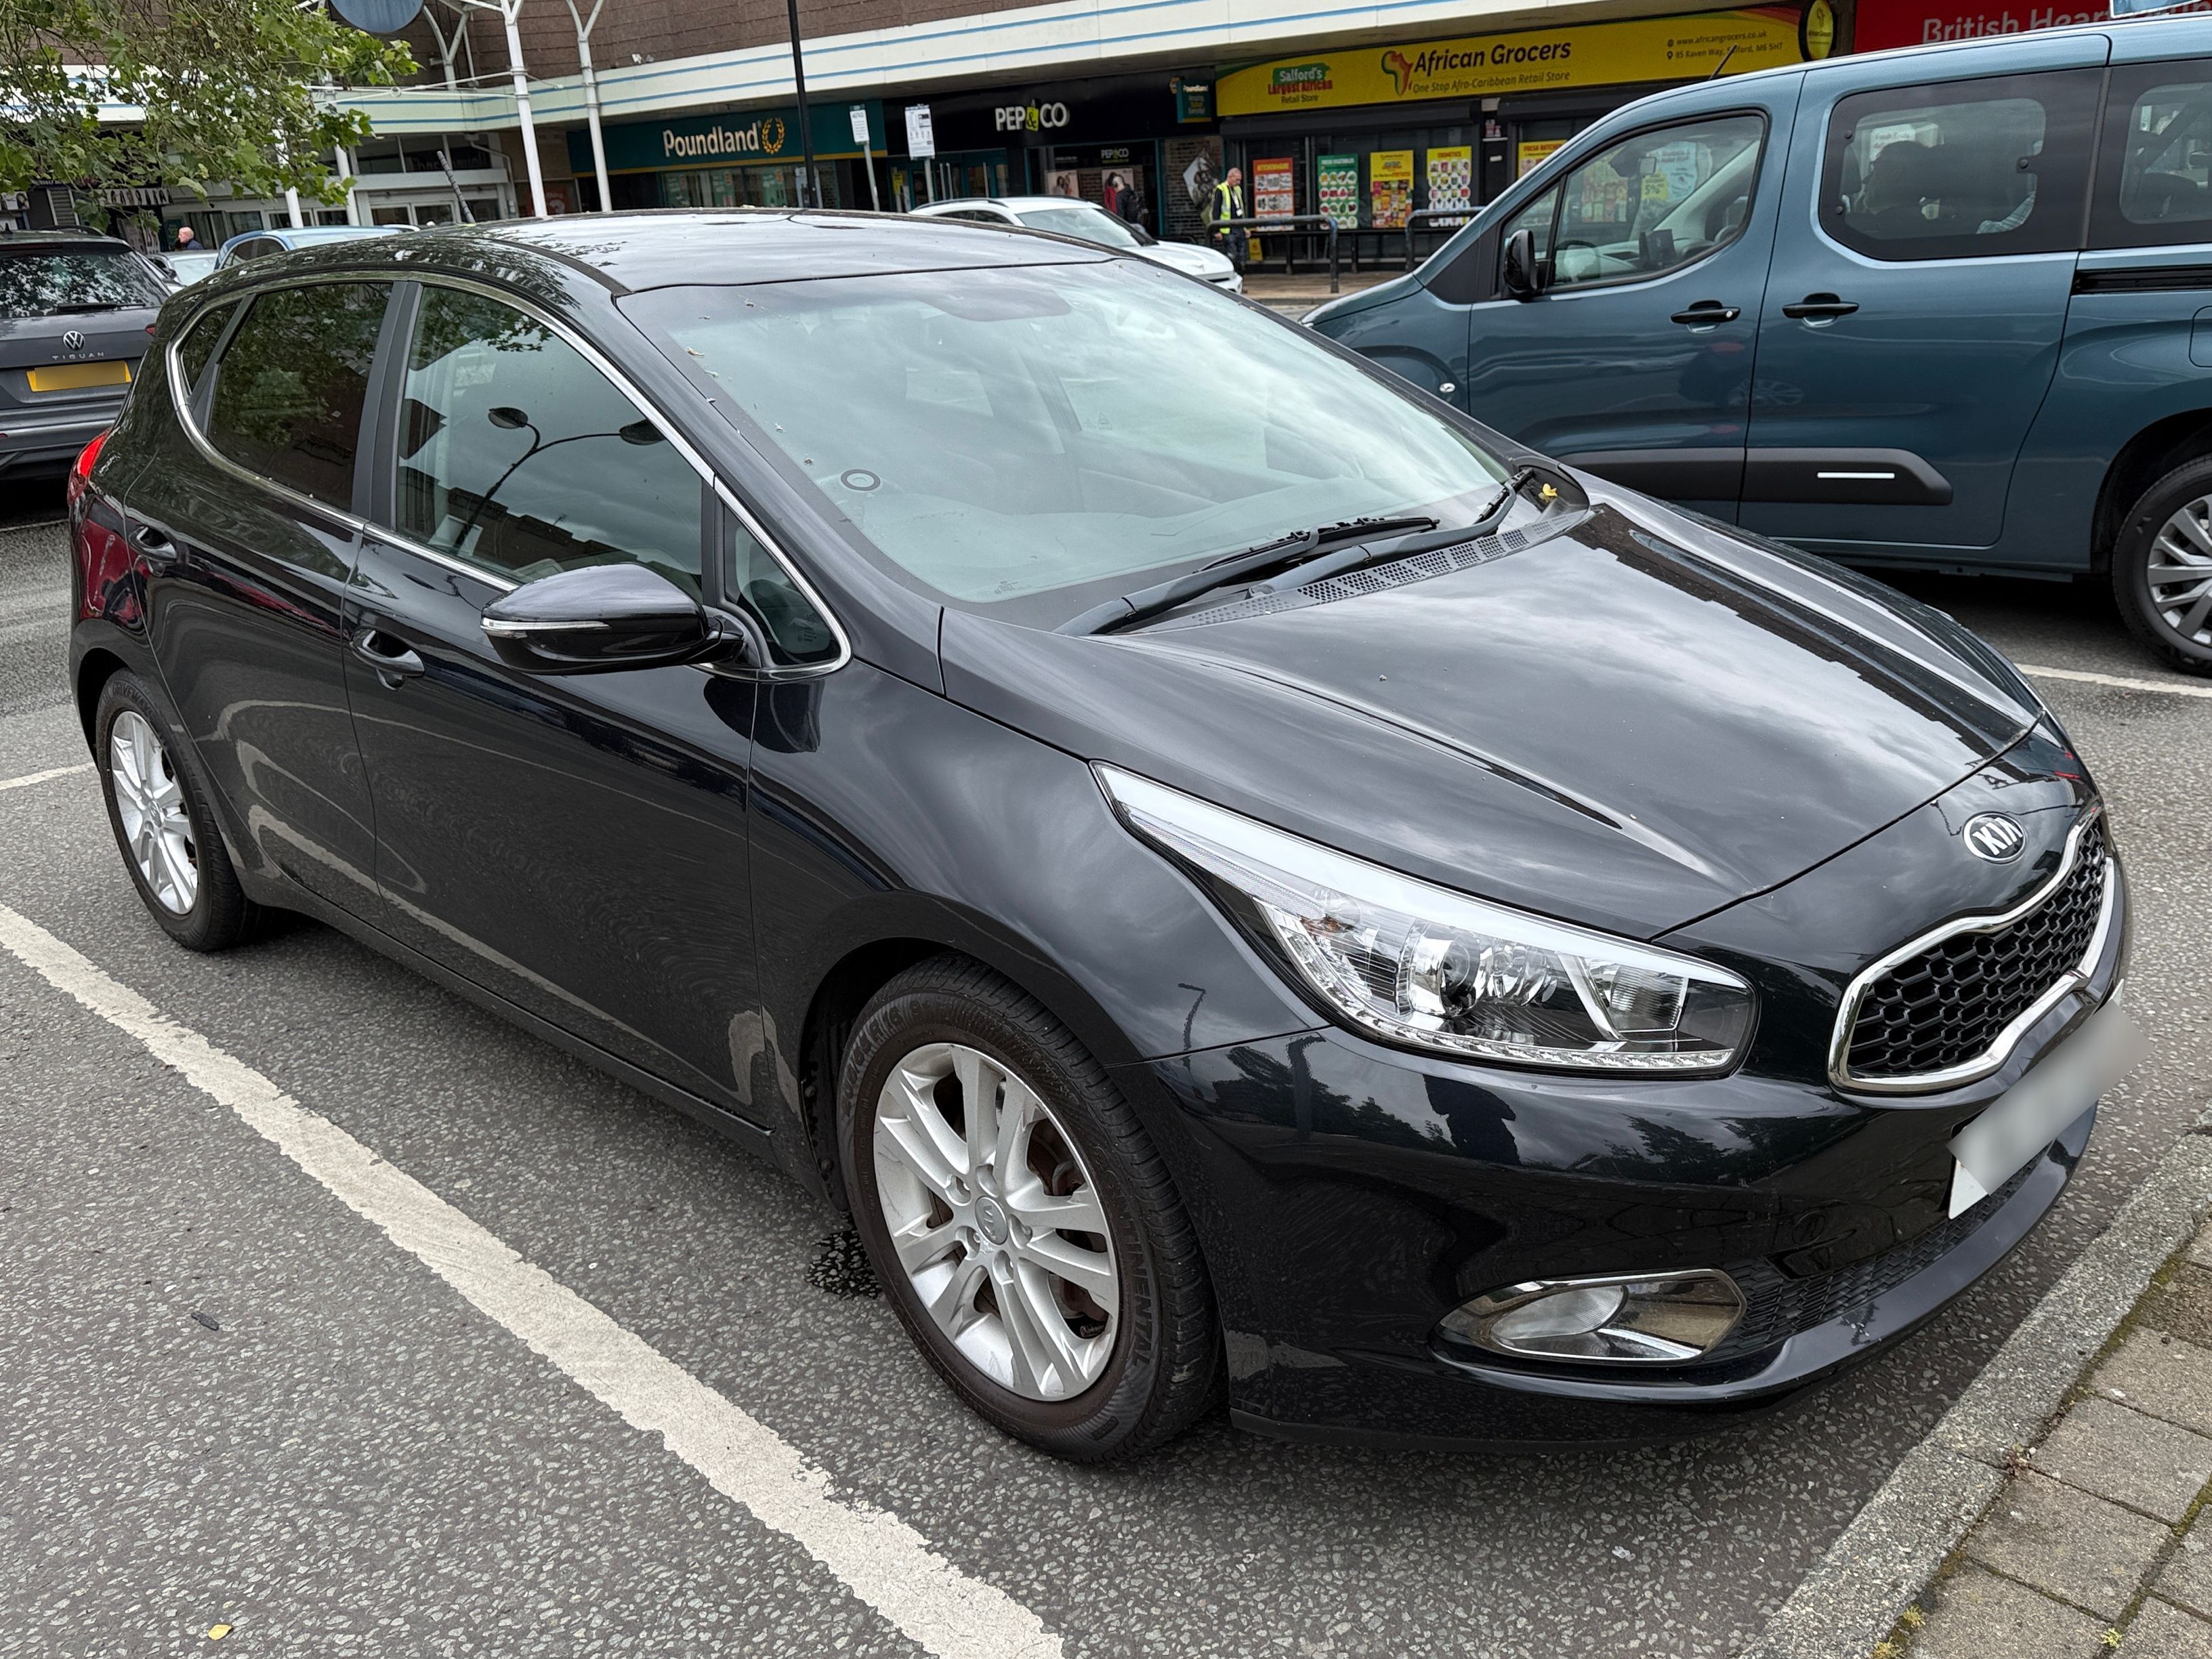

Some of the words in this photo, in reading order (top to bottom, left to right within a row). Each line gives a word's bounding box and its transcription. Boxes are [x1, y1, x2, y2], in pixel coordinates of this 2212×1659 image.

[1922, 11, 2019, 44] British
[2031, 7, 2112, 31] Hear
[1677, 30, 1767, 45] www.africangrocers.co.uk
[1686, 50, 1707, 58] Raven
[1769, 42, 1783, 50] 5HT
[1414, 49, 1485, 77] African
[1491, 42, 1571, 66] Grocers
[1280, 66, 1322, 82] Salford's
[1413, 84, 1430, 94] One
[1431, 81, 1449, 93] Stop
[1452, 77, 1517, 91] Afro-Caribbean
[1518, 72, 1544, 84] Retail
[1546, 71, 1570, 82] Store
[1301, 94, 1318, 102] Store
[663, 123, 759, 157] Poundland
[52, 352, 104, 360] TIGUAN
